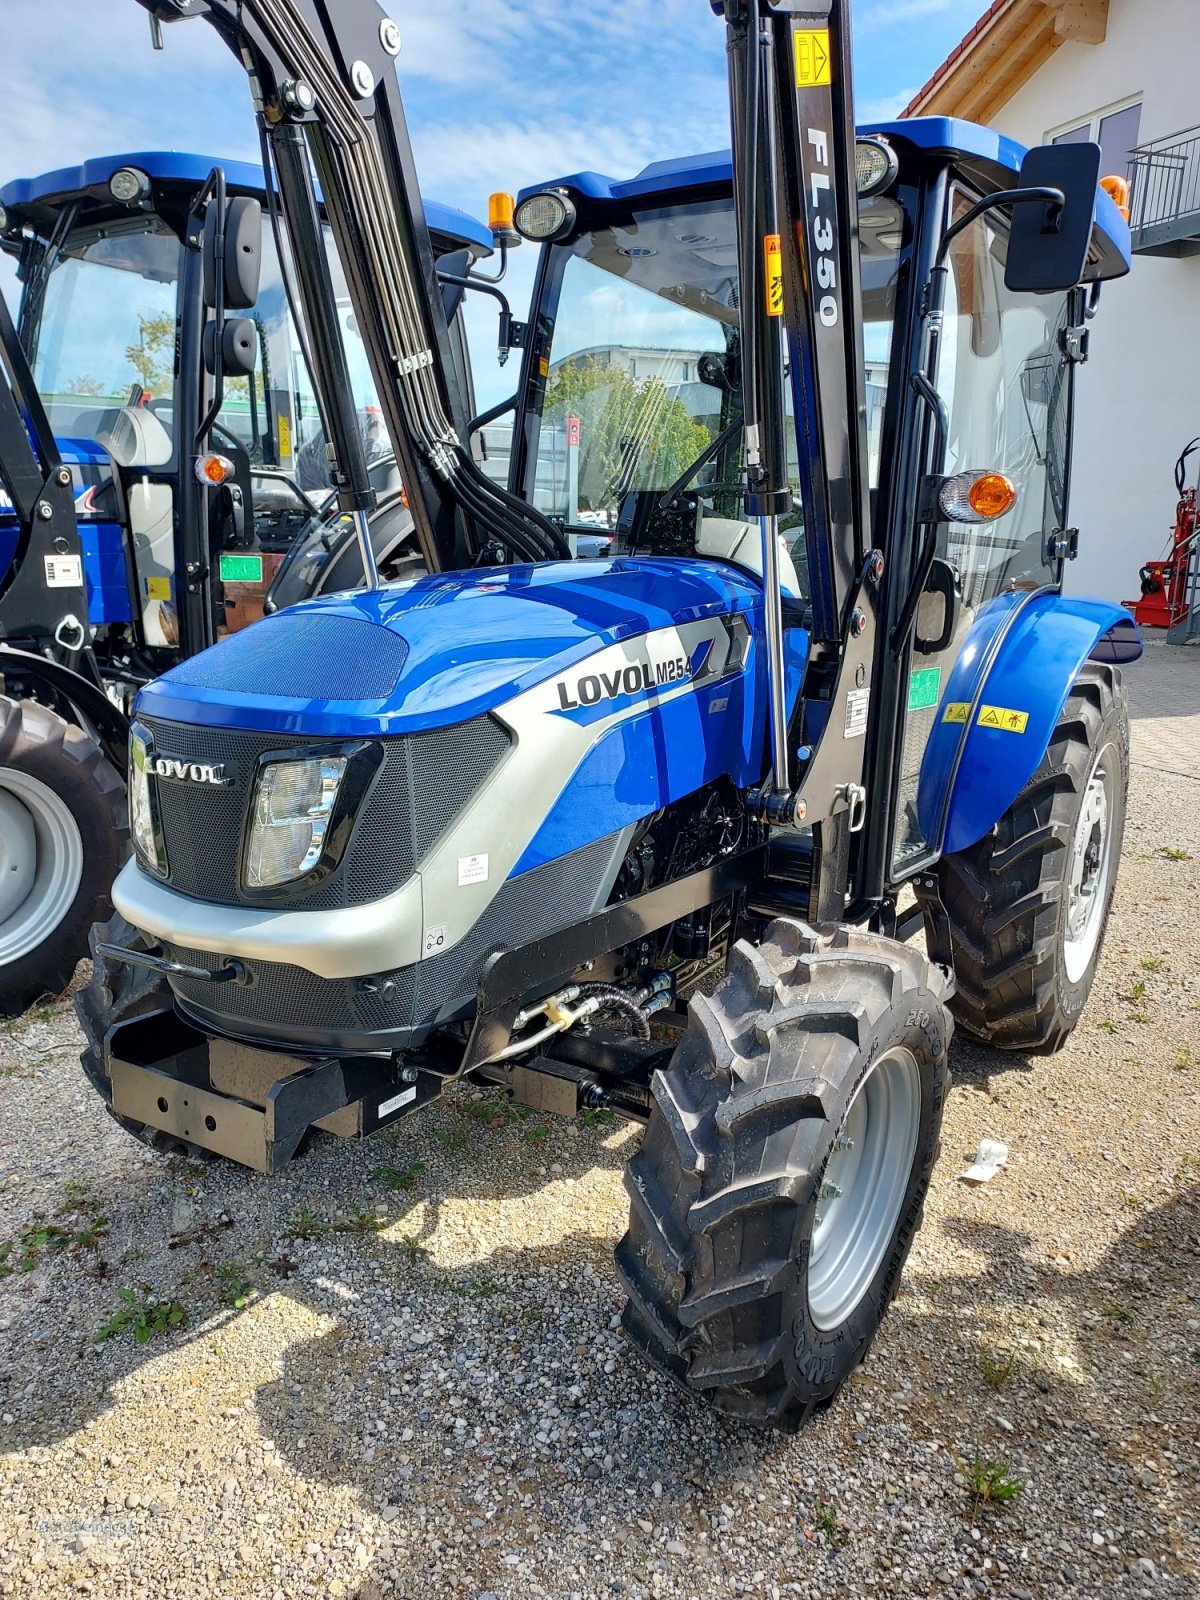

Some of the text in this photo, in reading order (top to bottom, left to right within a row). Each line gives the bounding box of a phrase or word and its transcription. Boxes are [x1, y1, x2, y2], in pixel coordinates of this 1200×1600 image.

[808, 128, 838, 327] FL350
[557, 656, 692, 710] LOVOL M254
[143, 757, 231, 784] LOVOL
